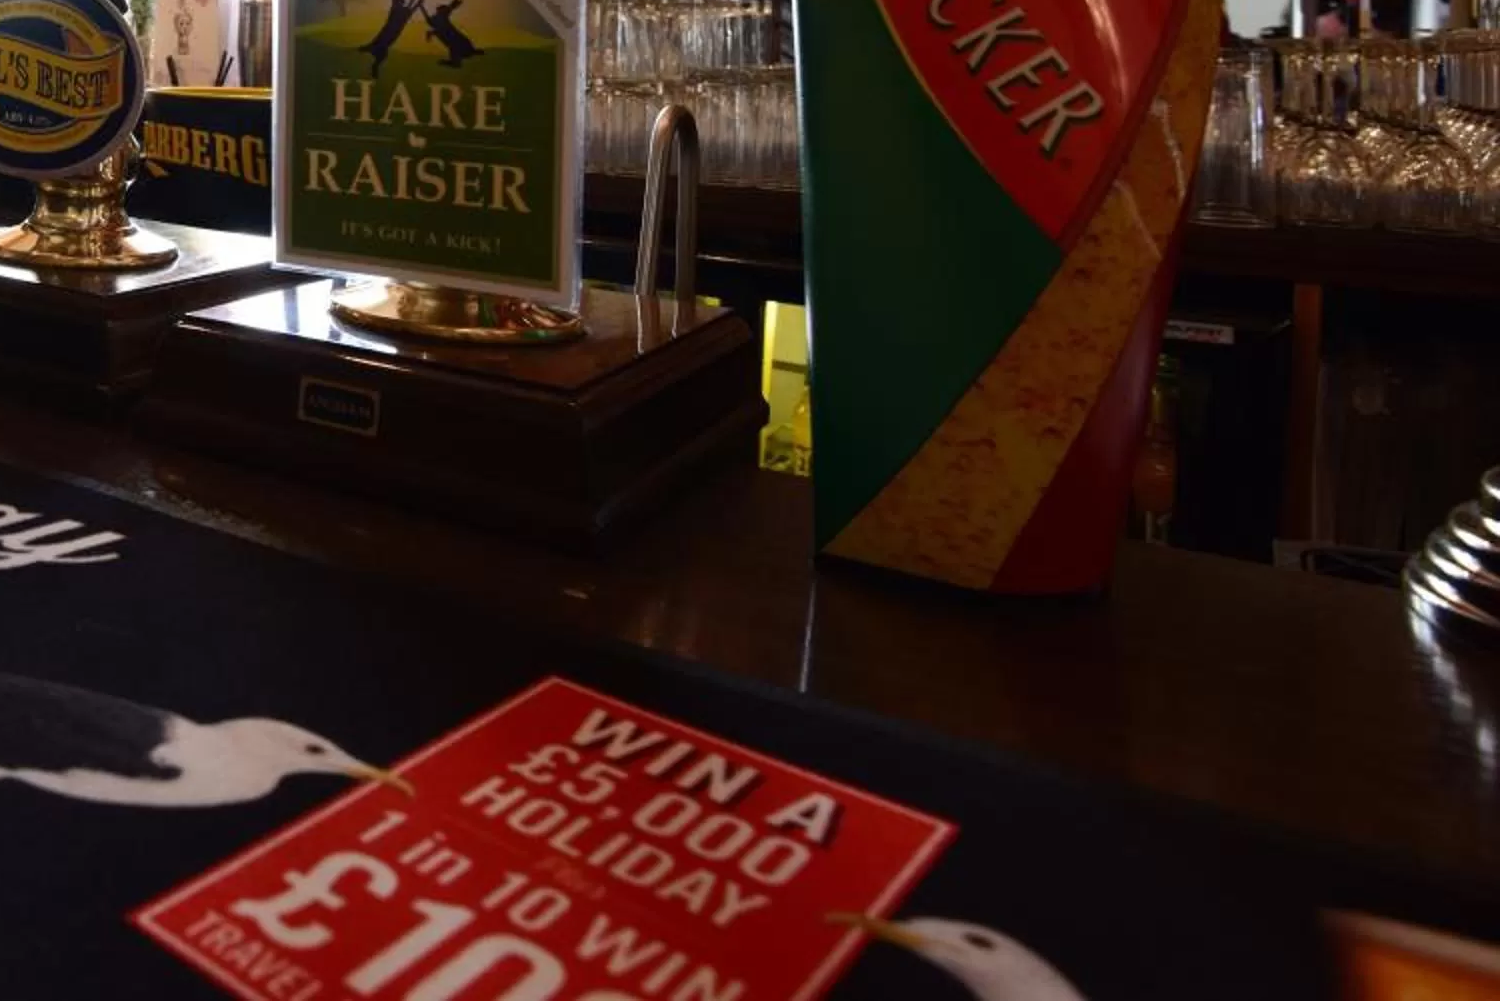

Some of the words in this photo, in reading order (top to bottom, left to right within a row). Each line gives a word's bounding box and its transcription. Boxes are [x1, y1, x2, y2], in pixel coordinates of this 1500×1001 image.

[36, 60, 110, 109] BEST
[330, 77, 506, 132] HARE
[303, 148, 532, 214] RAISER
[341, 220, 374, 237] IT'S
[379, 224, 418, 244] GOT
[427, 231, 438, 247] A
[446, 233, 501, 255] KICK!
[507, 743, 812, 887] £5,000
[571, 707, 762, 804] WIN
[765, 791, 841, 844] A
[359, 809, 409, 845] 1
[398, 831, 474, 887] in
[481, 870, 572, 932] 10
[575, 912, 750, 1001] WIN
[460, 776, 771, 927] HOLIDAY
[228, 851, 640, 1001] £10
